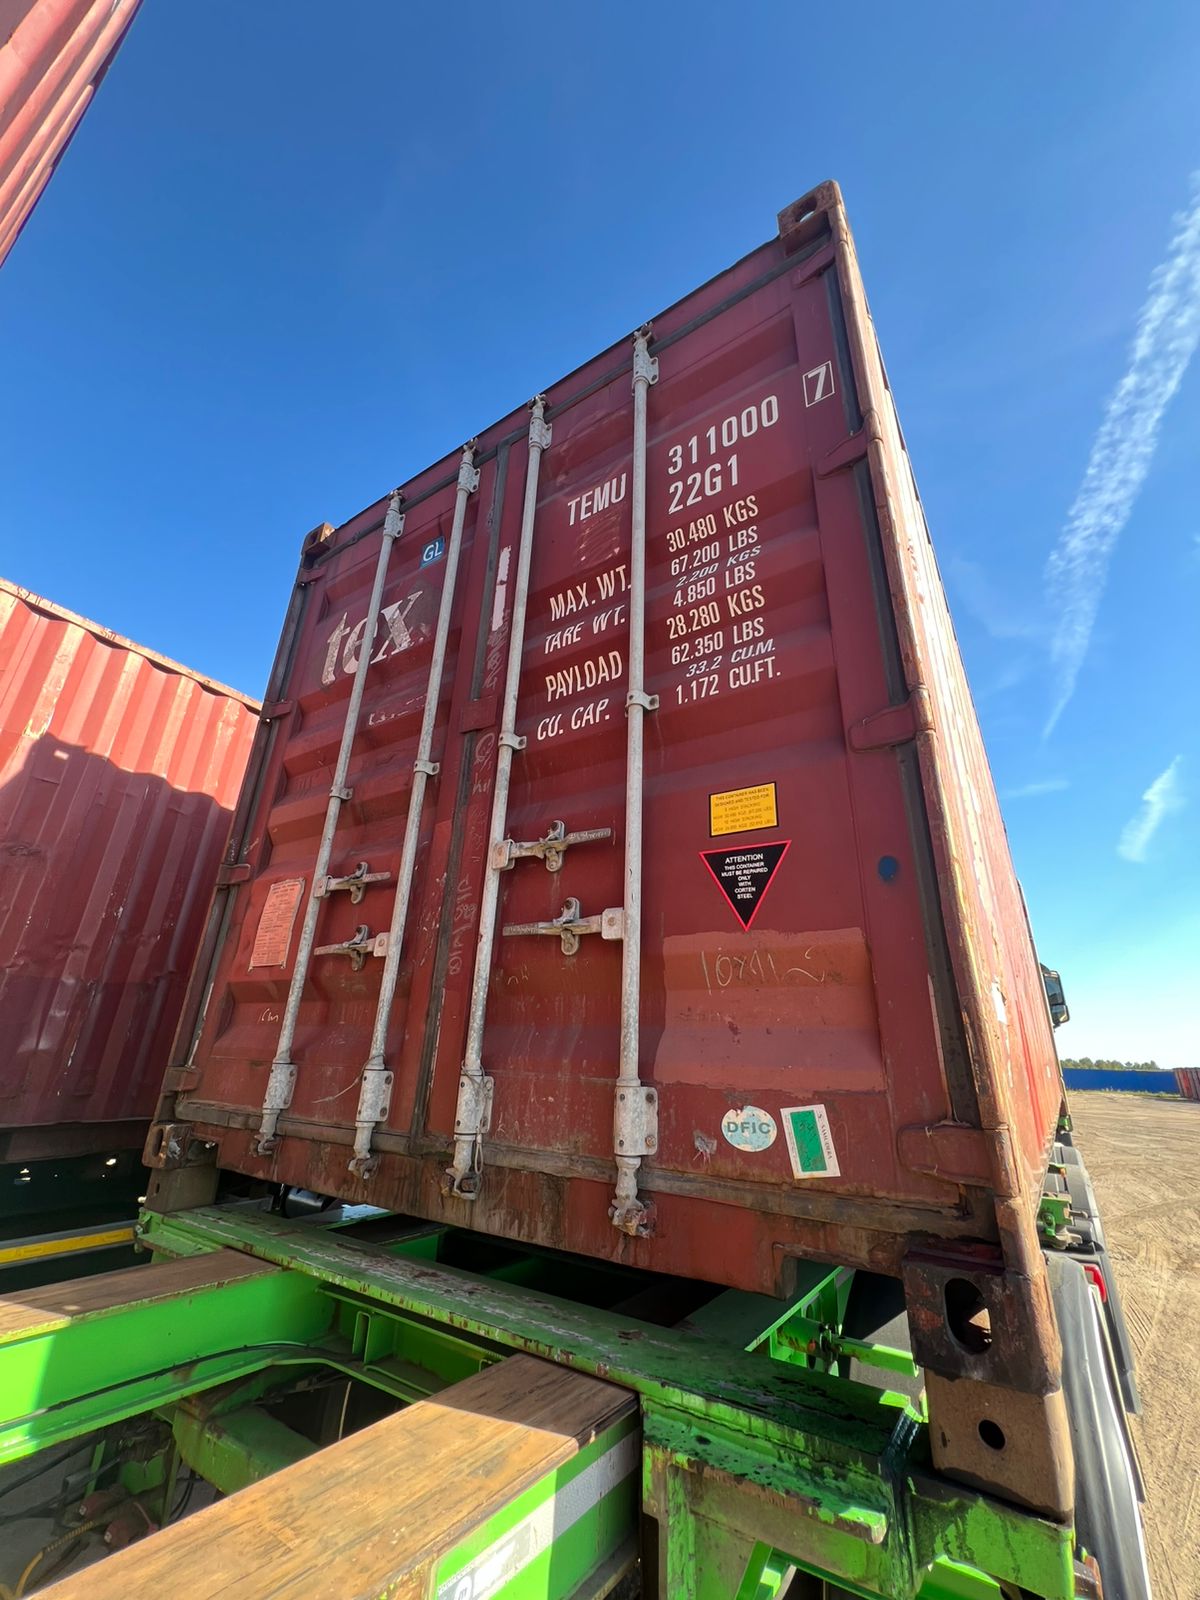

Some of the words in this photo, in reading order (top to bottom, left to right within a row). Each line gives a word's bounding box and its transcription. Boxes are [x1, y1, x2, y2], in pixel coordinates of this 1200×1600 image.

[568, 473, 627, 526] TEMU
[667, 395, 779, 475] 311000
[807, 365, 827, 402] 7
[668, 454, 738, 515] 22G1
[423, 542, 442, 562] GL
[550, 582, 596, 621] MAX.
[597, 564, 632, 601] WT.
[666, 513, 717, 553] 30.480
[723, 495, 759, 528] KGS
[671, 541, 720, 576] 67.200
[728, 525, 758, 550] LBS
[544, 621, 584, 654] TARE
[592, 605, 625, 635] WT.
[675, 563, 719, 588] 2.200
[727, 545, 762, 567] KGS
[673, 576, 716, 608] 4.850
[725, 561, 756, 590] LBS
[545, 650, 623, 703] PAYLOAD
[666, 601, 720, 639] 28.280
[727, 584, 765, 618] KGS
[671, 631, 723, 665] 62.350
[733, 617, 765, 645] LBS
[537, 713, 564, 741] CU.
[570, 698, 610, 730] CAP.
[685, 655, 722, 678] 33.2
[675, 674, 719, 705] 1.172
[725, 853, 764, 864] ATTENTION
[736, 862, 765, 870] CONTAINER
[727, 1121, 771, 1134] DFIC
